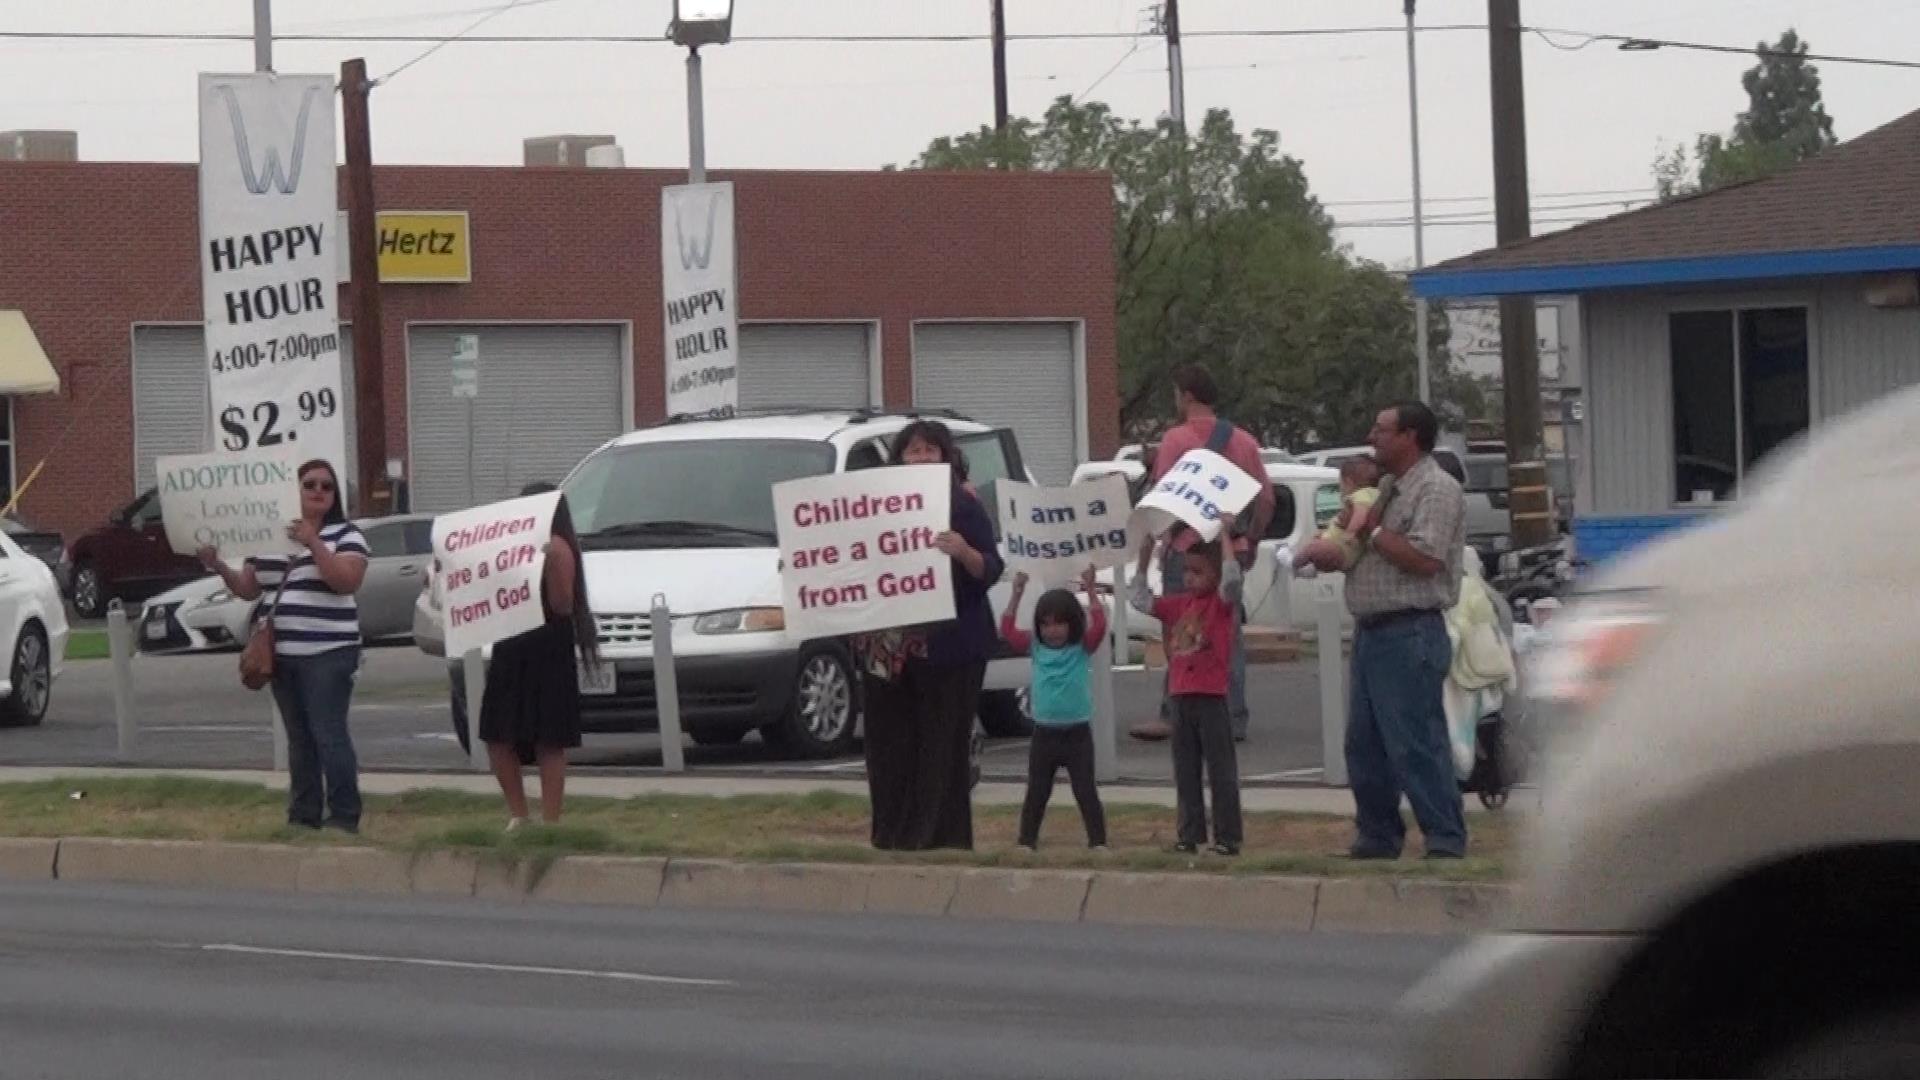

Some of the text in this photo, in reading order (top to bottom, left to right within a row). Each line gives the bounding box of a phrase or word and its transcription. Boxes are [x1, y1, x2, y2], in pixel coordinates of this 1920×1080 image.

[210, 222, 323, 273] HAPPY
[378, 228, 455, 255] Hertz
[224, 277, 324, 324] HOUR
[668, 288, 725, 326] HAPPY
[212, 333, 336, 373] 4:00-7:00pm
[675, 327, 728, 360] HOUR
[164, 460, 293, 493] ADOPTION:
[1209, 473, 1230, 491] a
[201, 497, 280, 521] Loving
[793, 492, 924, 528] Children
[1008, 497, 1107, 525] I am a
[194, 519, 272, 549] Option
[444, 516, 536, 552] Children
[792, 526, 936, 569] are a Gift
[1006, 528, 1127, 560] blessing
[446, 544, 536, 592] are a Gift
[449, 578, 531, 628] from God
[798, 565, 936, 610] from God
